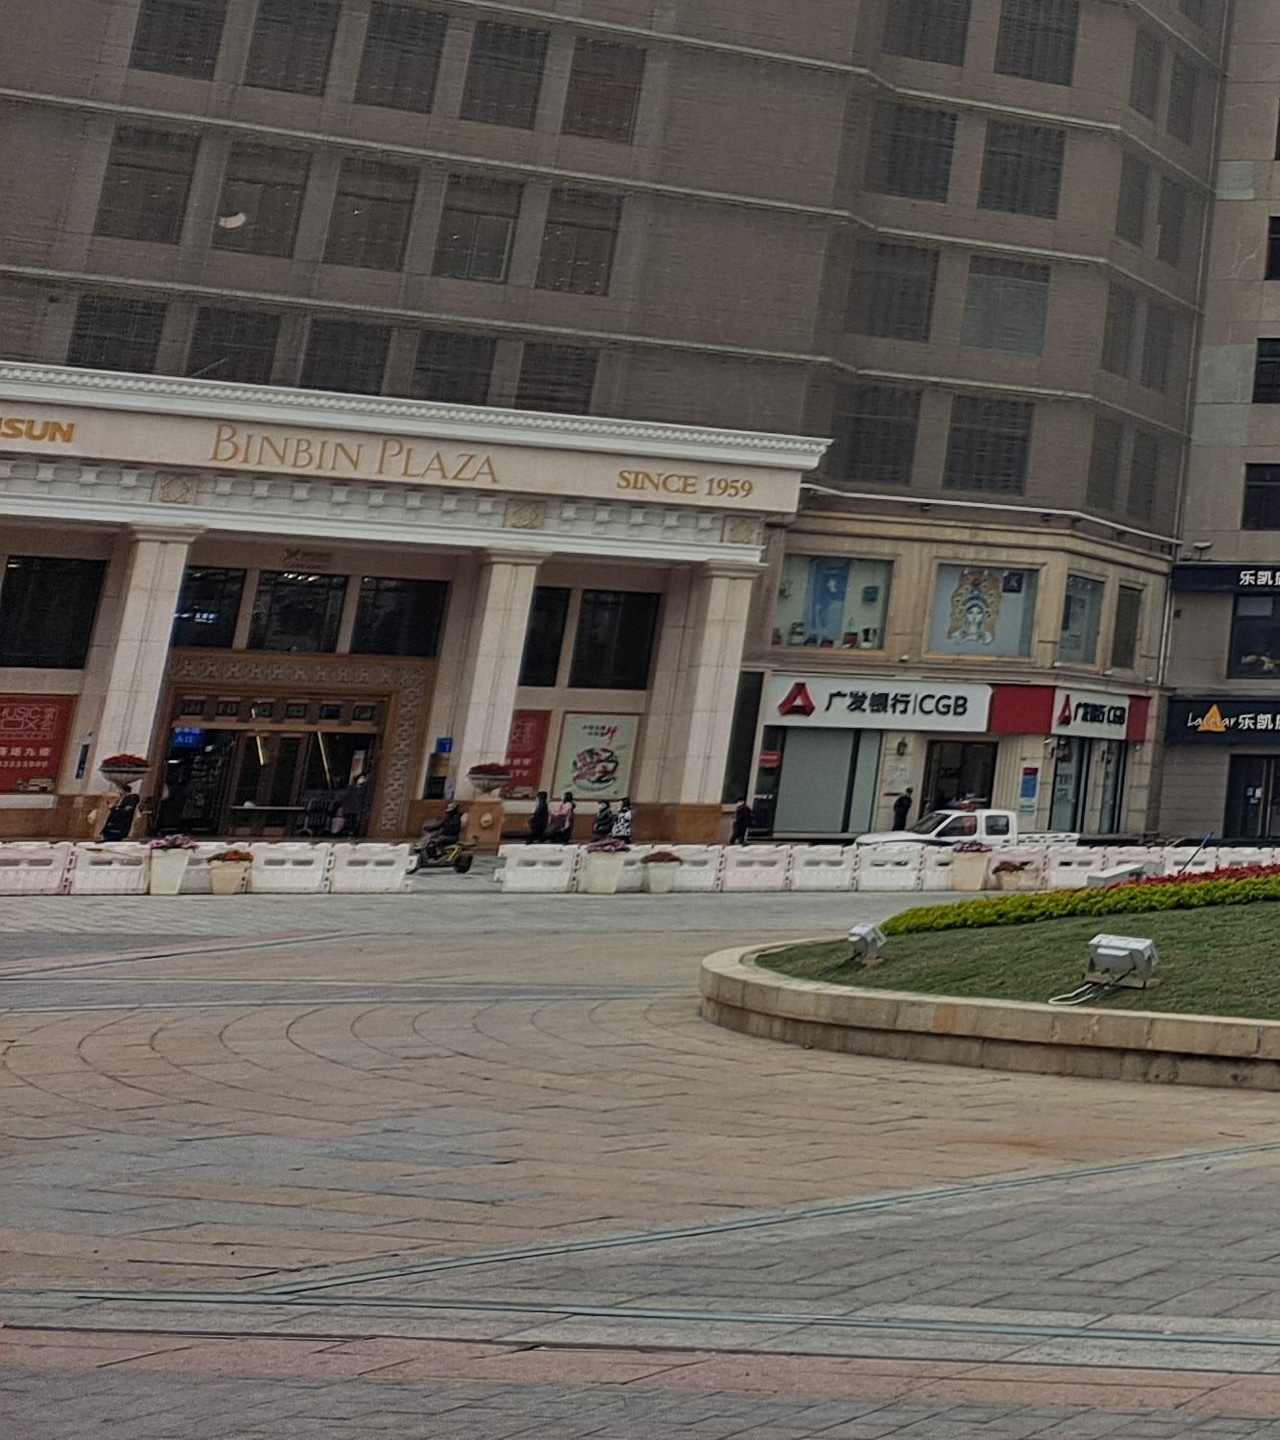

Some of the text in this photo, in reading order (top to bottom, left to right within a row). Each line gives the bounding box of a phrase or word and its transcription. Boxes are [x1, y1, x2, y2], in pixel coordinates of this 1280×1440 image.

[0, 417, 75, 442] SUN
[210, 423, 499, 484] BINBIN PLAZA
[616, 469, 753, 499] SINCE 1959
[824, 691, 968, 717] 广发银行 CGB
